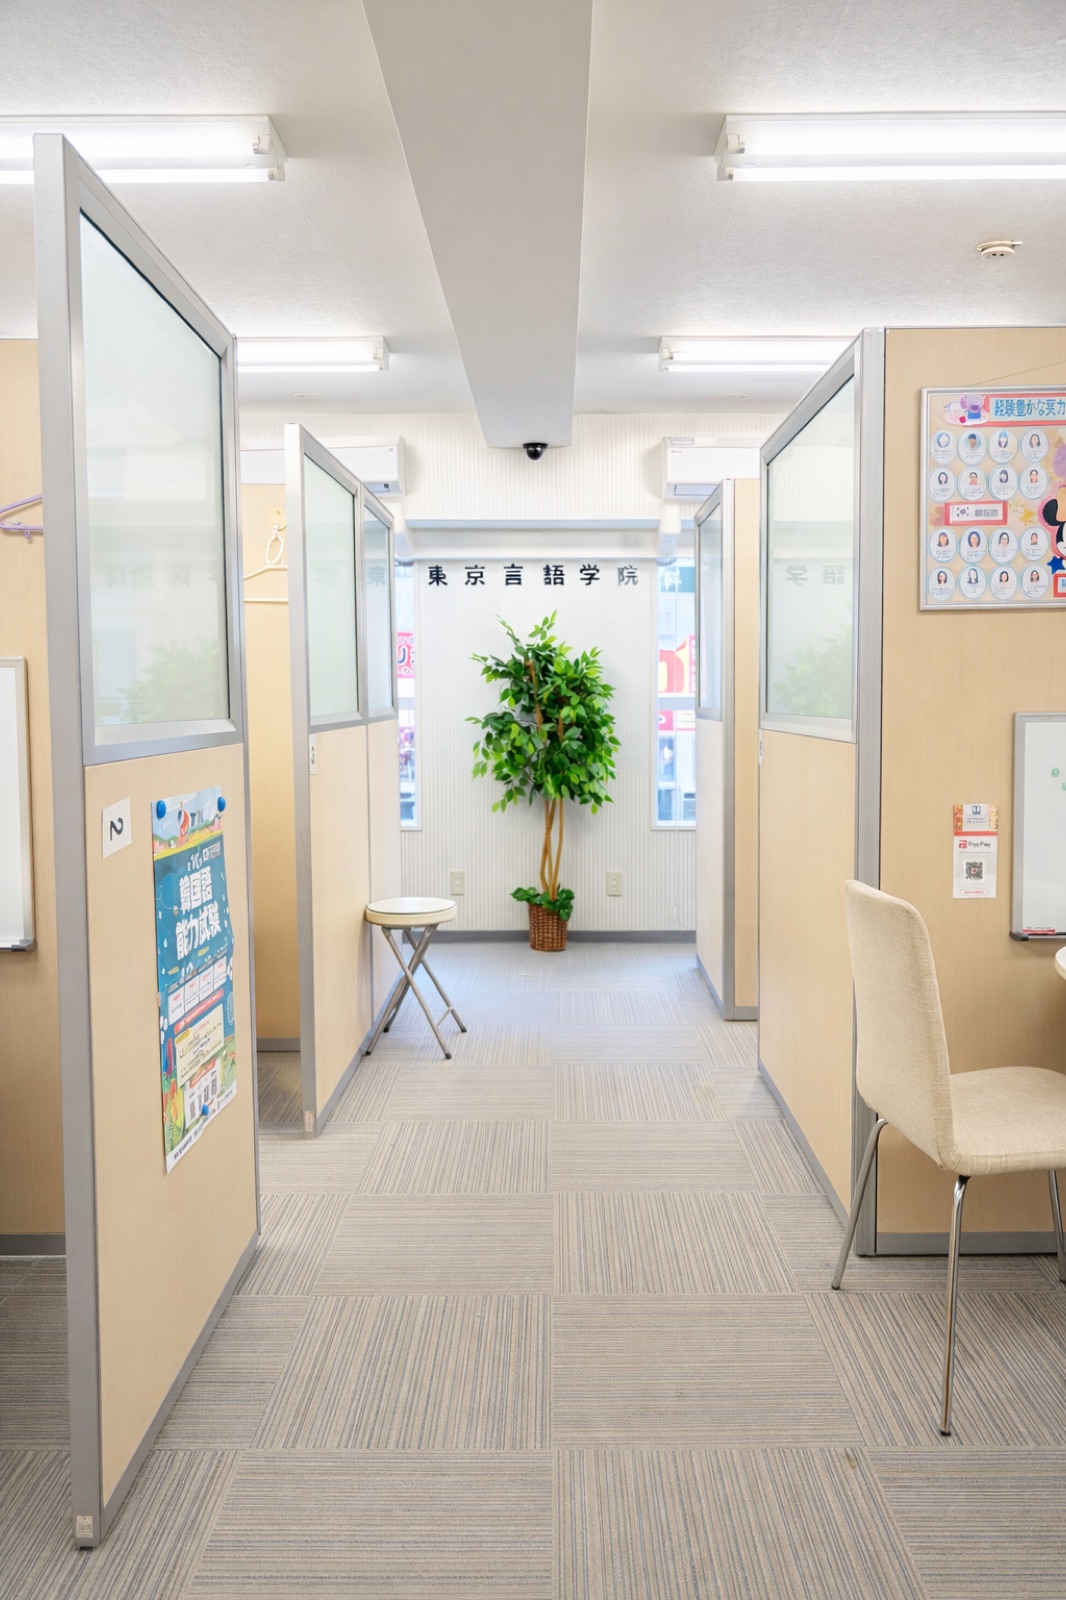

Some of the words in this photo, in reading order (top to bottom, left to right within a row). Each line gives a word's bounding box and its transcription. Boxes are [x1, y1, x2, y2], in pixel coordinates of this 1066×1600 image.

[427, 563, 639, 587] 東京言語学院
[109, 817, 125, 841] 2
